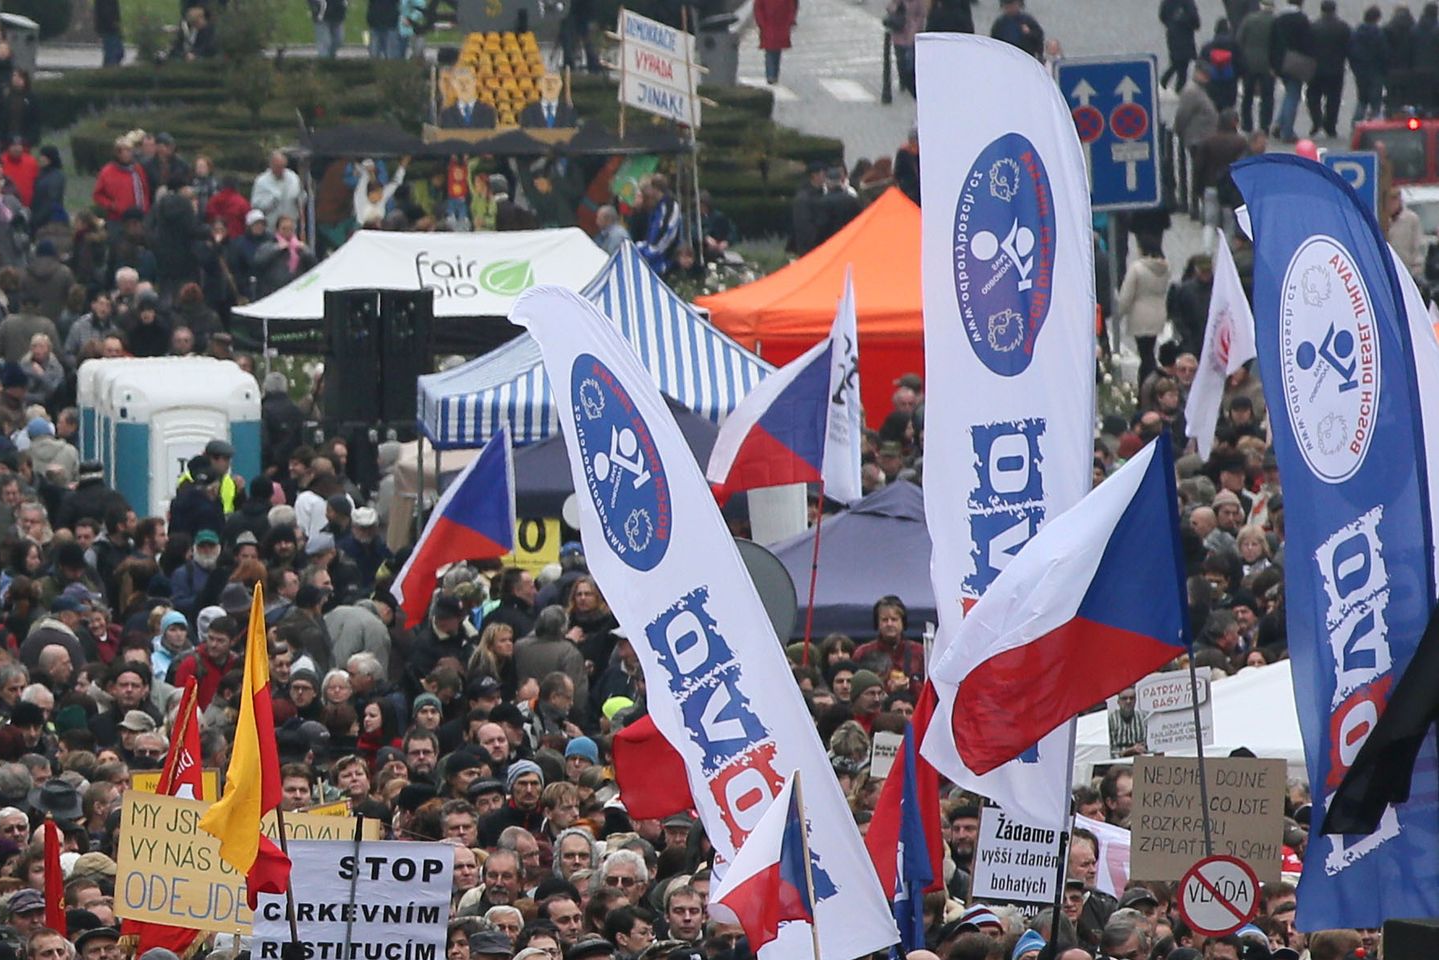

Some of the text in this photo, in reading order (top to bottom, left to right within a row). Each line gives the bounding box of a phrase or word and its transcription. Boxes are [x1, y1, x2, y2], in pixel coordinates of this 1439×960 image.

[416, 251, 478, 290] fair
[1143, 766, 1268, 788] NEJSME DOJNÉ
[1142, 788, 1194, 810] KRÁVY
[131, 801, 162, 830] MY
[130, 836, 164, 864] VY
[164, 840, 211, 871] NÁS
[981, 846, 1059, 869] vyšší zdaněn
[339, 856, 444, 883] STOP
[990, 873, 1047, 897] bohatých
[1188, 874, 1249, 903] VLÁDA
